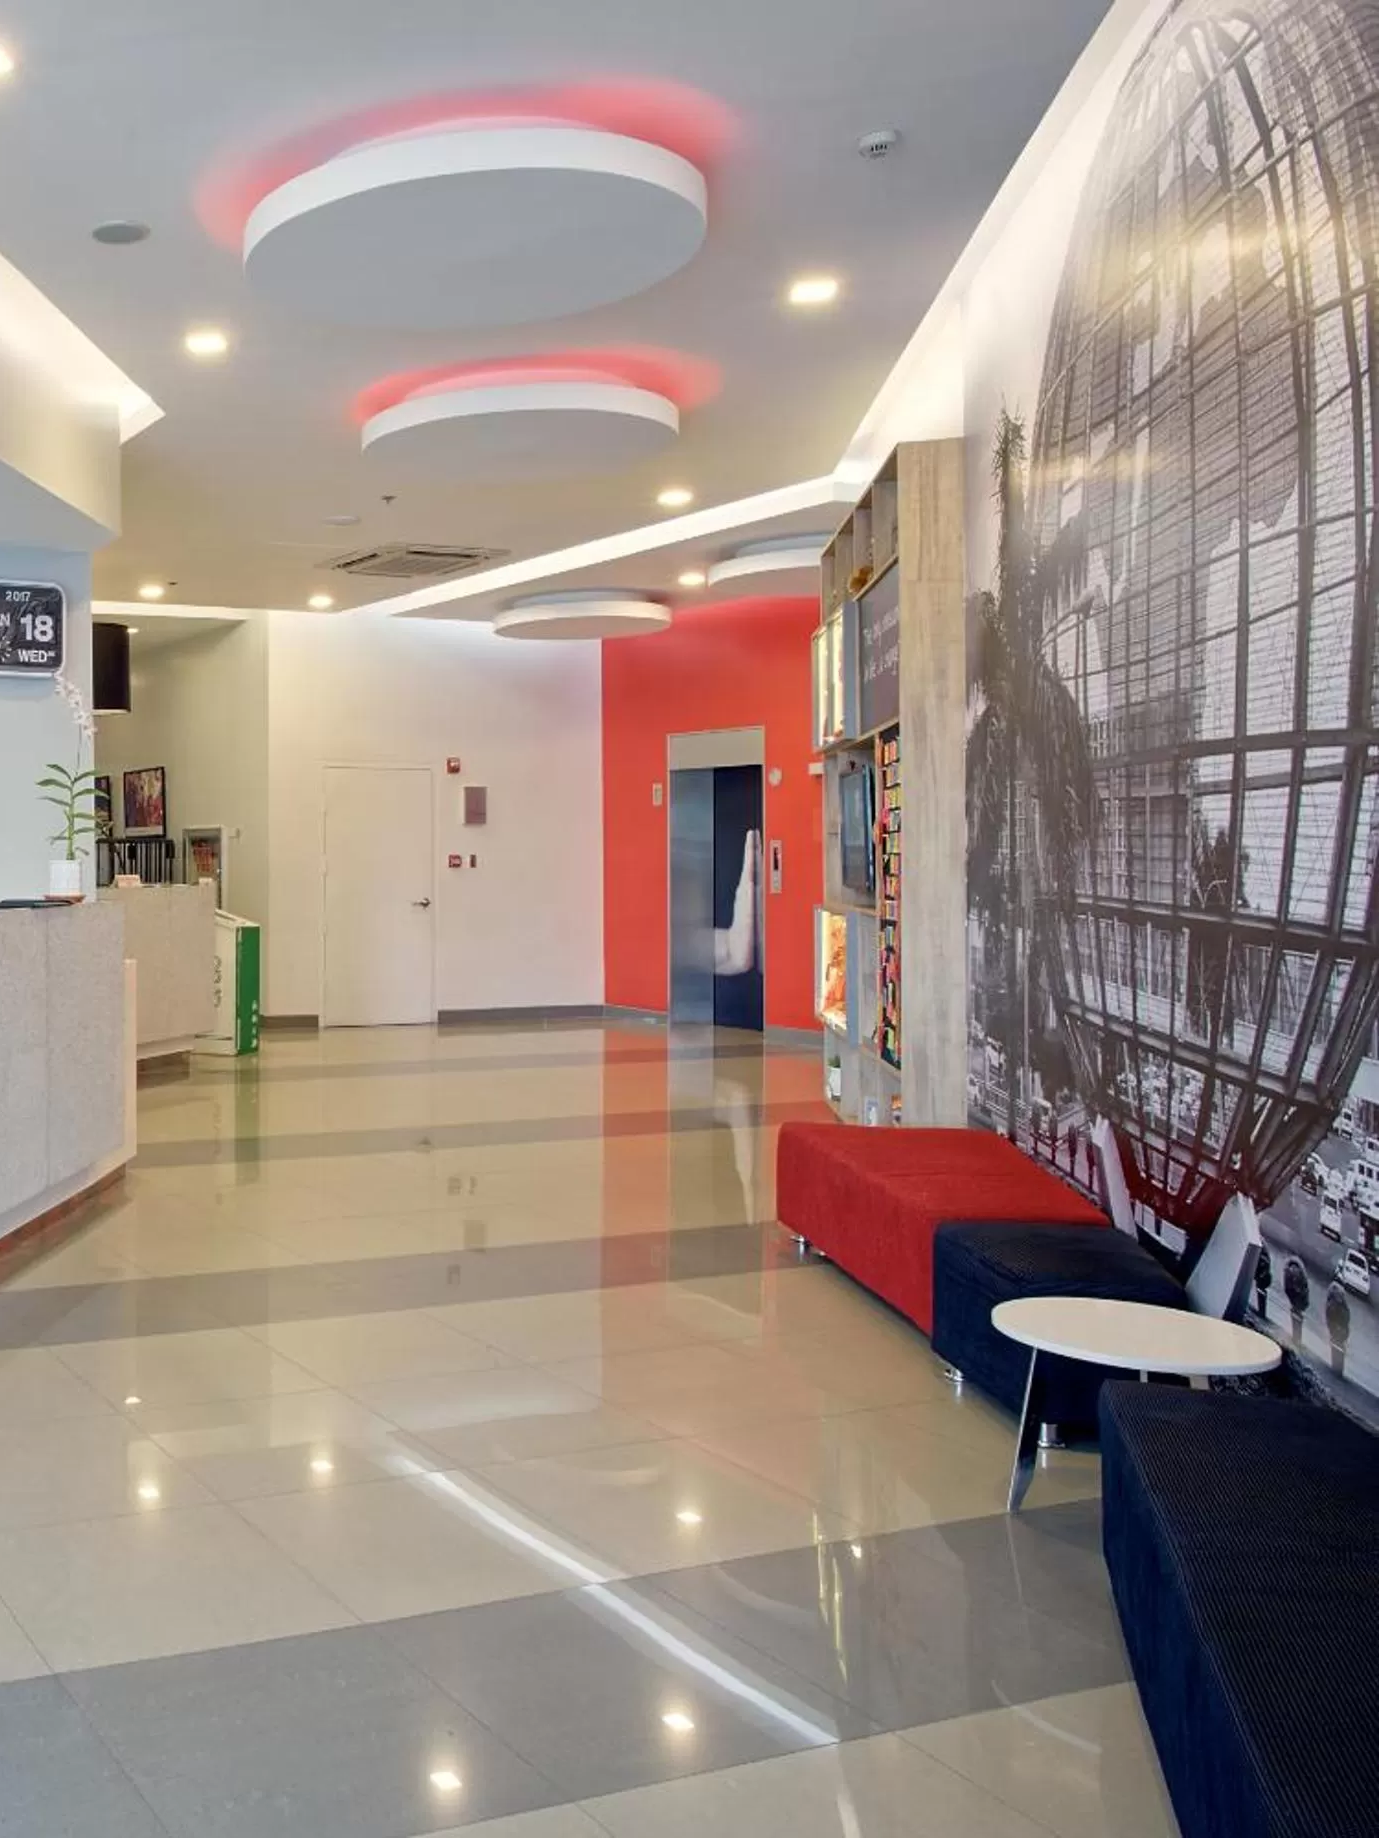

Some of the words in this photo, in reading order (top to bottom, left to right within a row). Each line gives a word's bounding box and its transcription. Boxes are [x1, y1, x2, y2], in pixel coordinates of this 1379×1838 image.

[5, 591, 31, 602] 2017
[20, 613, 54, 642] 18
[17, 648, 48, 663] WED
